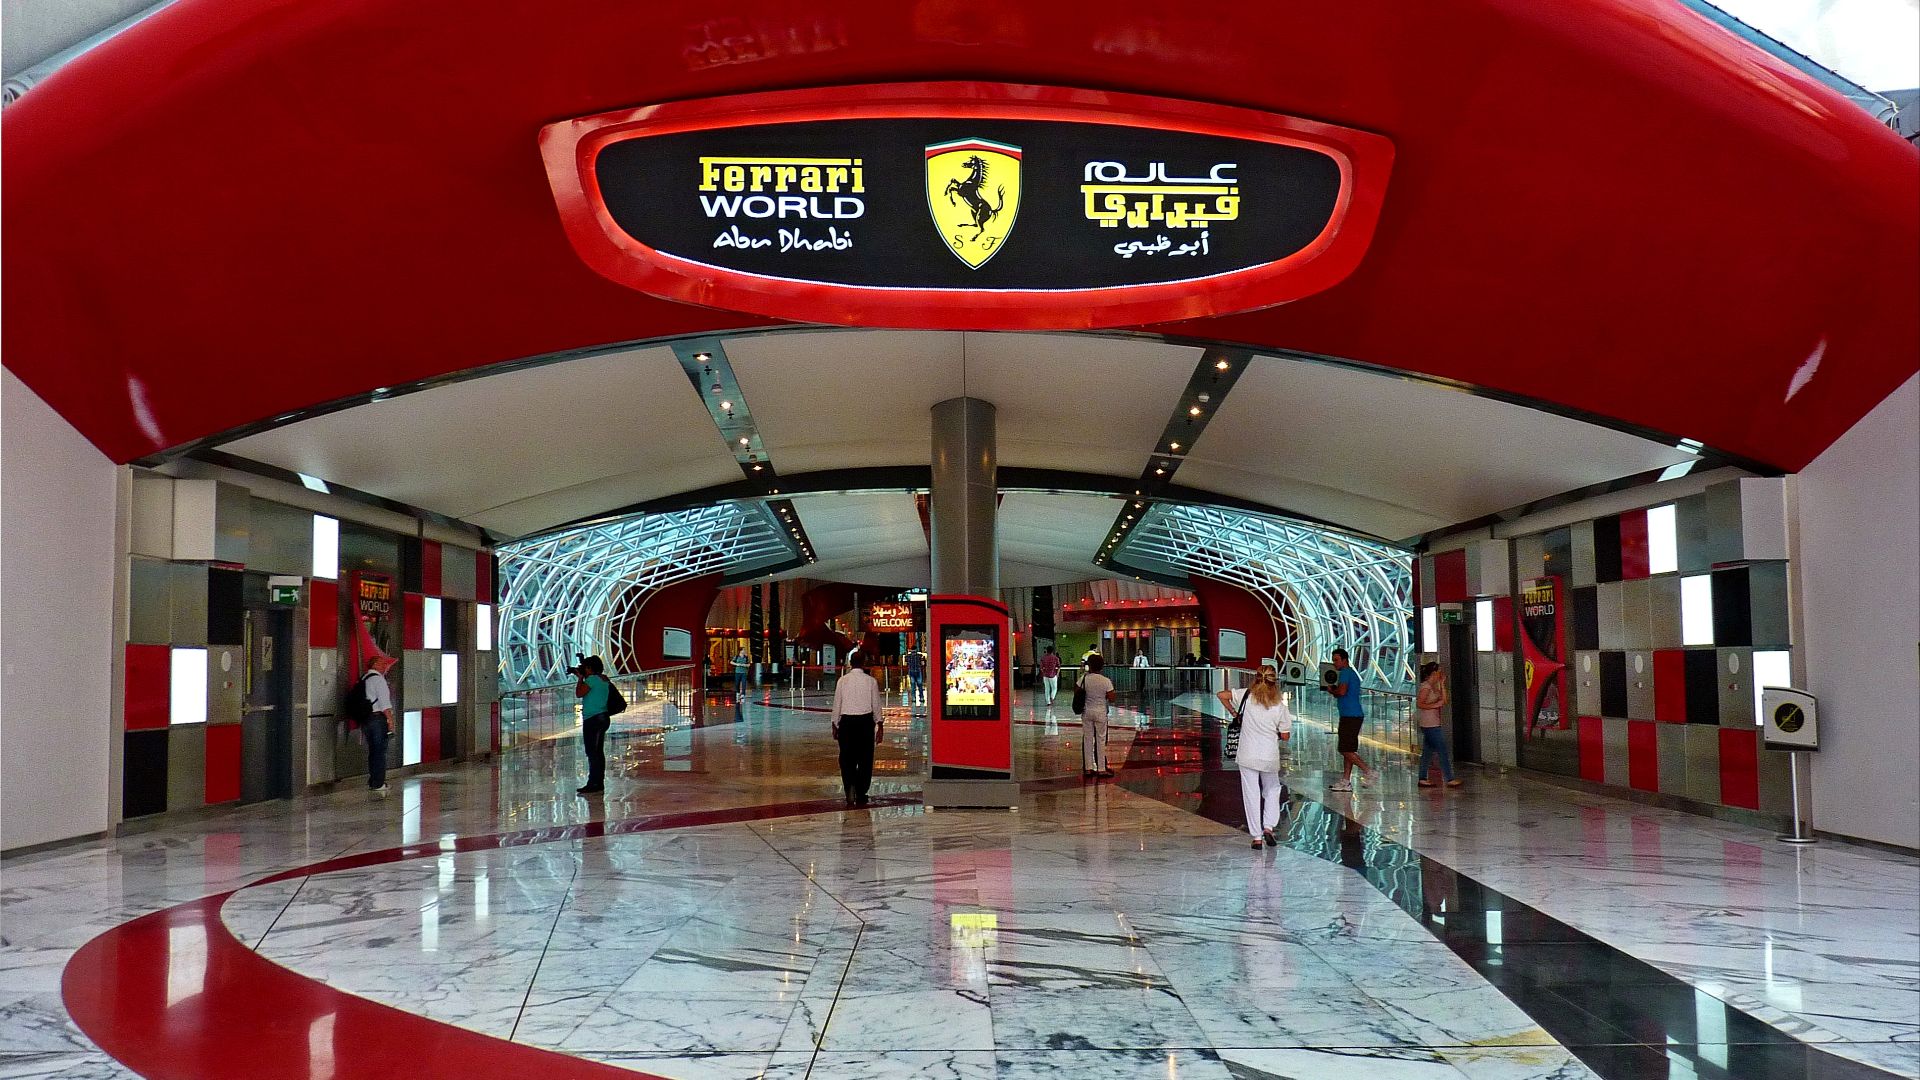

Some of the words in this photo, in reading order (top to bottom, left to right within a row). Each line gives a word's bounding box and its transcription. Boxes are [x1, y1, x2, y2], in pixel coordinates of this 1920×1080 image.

[699, 157, 865, 193] Ferrari
[699, 195, 865, 219] WORLD
[1080, 185, 1241, 229] فيراري
[713, 225, 772, 249] Abu
[778, 226, 853, 253] Dhabi
[953, 234, 964, 250] S
[360, 600, 390, 613] WORLD
[1525, 604, 1555, 617] WORLD
[873, 618, 913, 627] WELCOME
